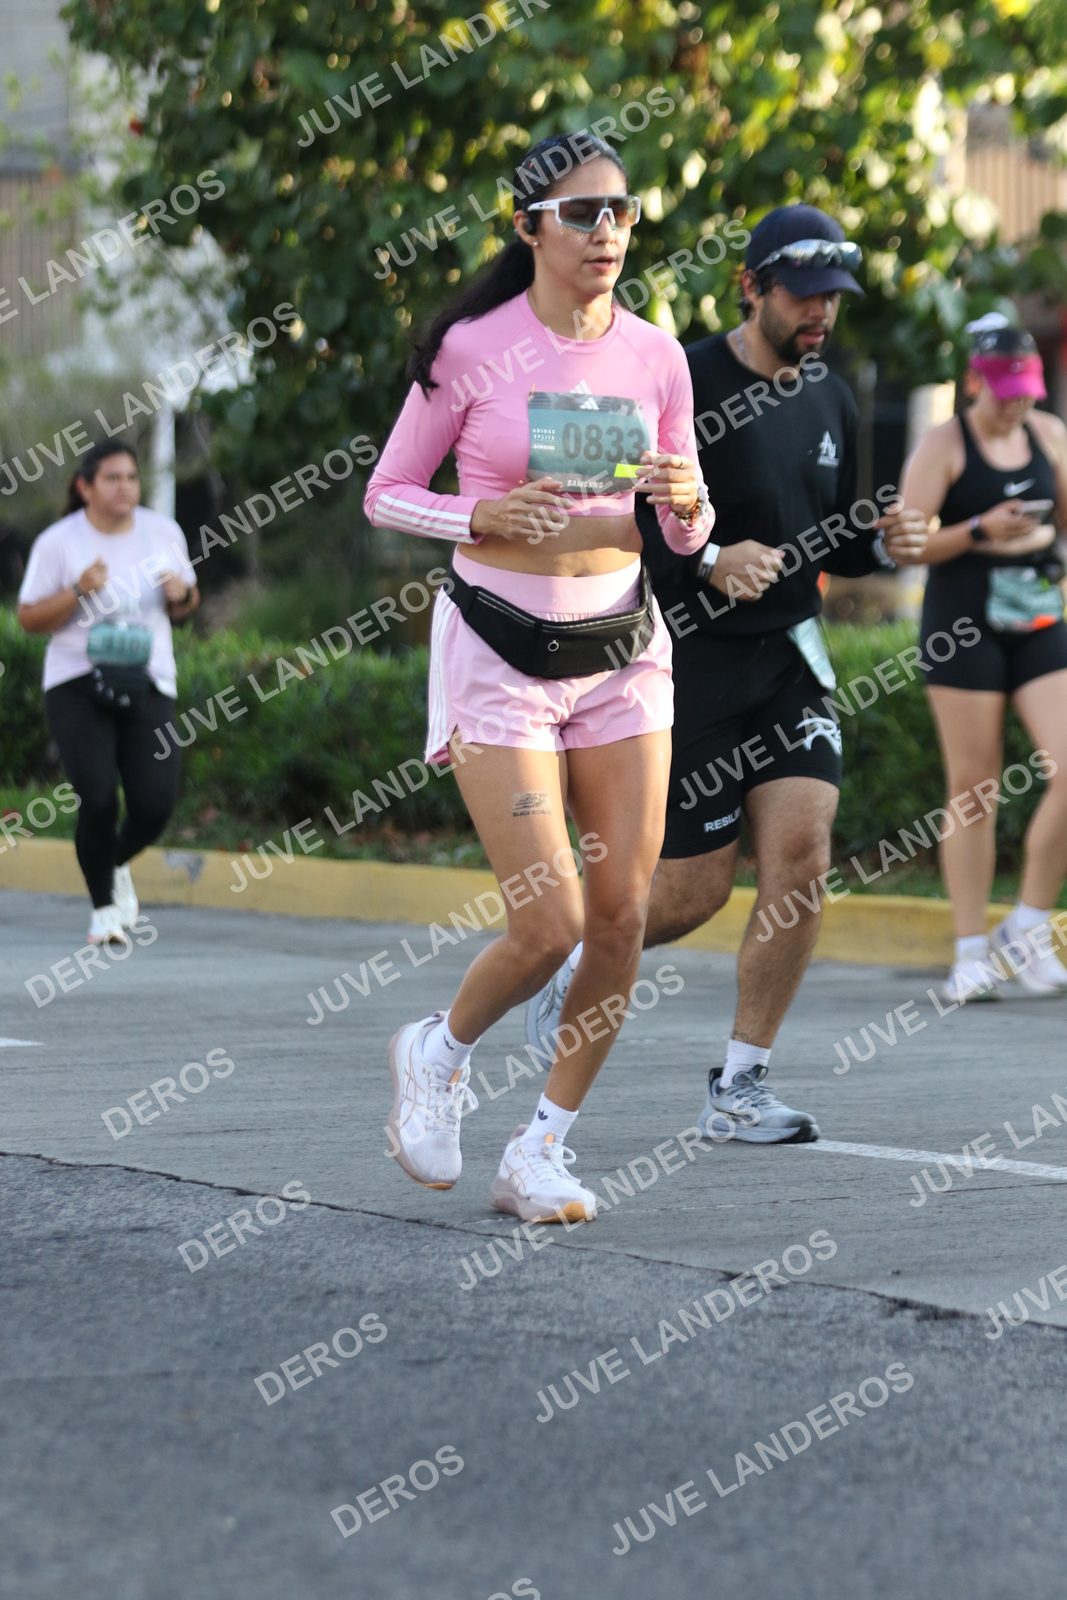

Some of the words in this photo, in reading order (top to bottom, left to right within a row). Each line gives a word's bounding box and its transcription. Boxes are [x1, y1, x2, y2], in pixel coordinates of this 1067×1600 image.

[562, 422, 645, 465] 0833
[567, 479, 604, 488] SAMSUNG
[704, 807, 740, 832] RESIL
